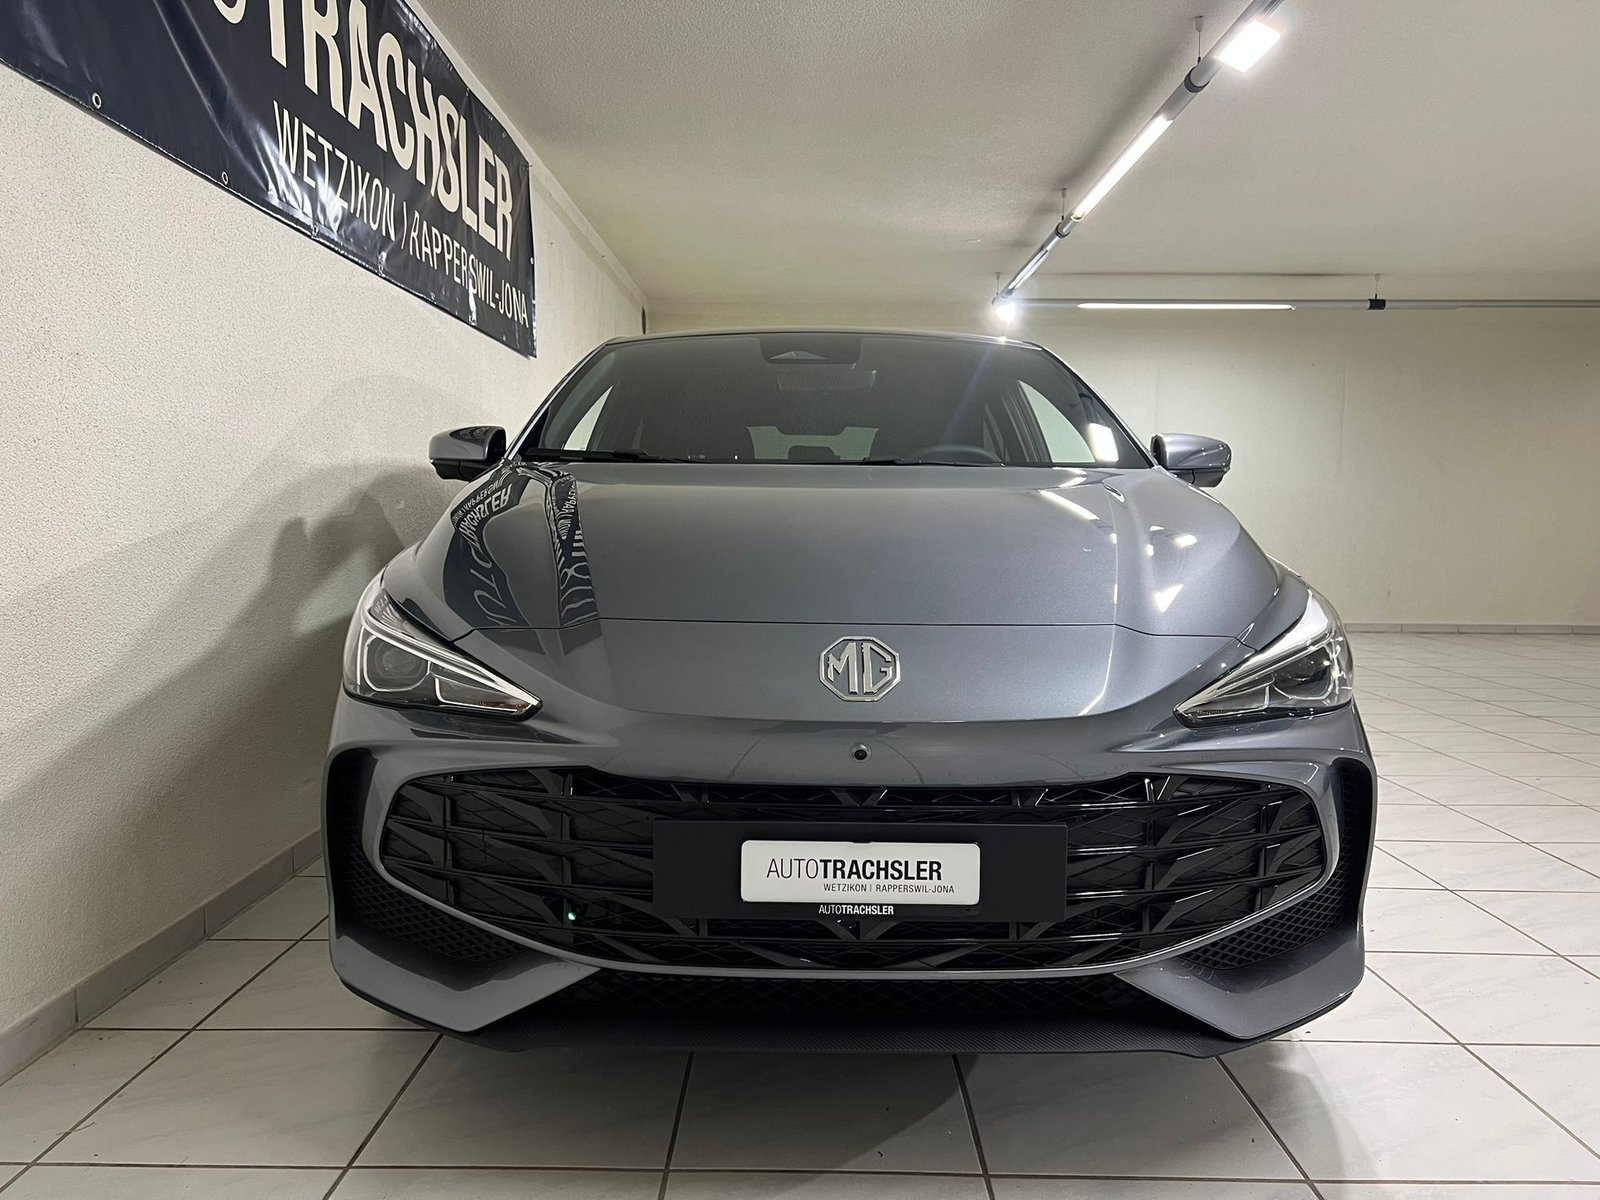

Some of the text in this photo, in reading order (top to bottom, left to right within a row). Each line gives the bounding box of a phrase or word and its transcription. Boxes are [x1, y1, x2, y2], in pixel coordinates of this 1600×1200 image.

[213, 0, 513, 261] RACHSLER
[273, 100, 396, 241] WETZIKON
[409, 210, 529, 328] RAPPERSWIL-JONA
[827, 641, 893, 694] MG
[766, 858, 942, 881] AUTOTRACHSLER
[823, 883, 867, 893] WETZIKON
[875, 884, 955, 894] RAPPERSWIL-JONA
[818, 904, 894, 915] AUTOTRACHSLER
